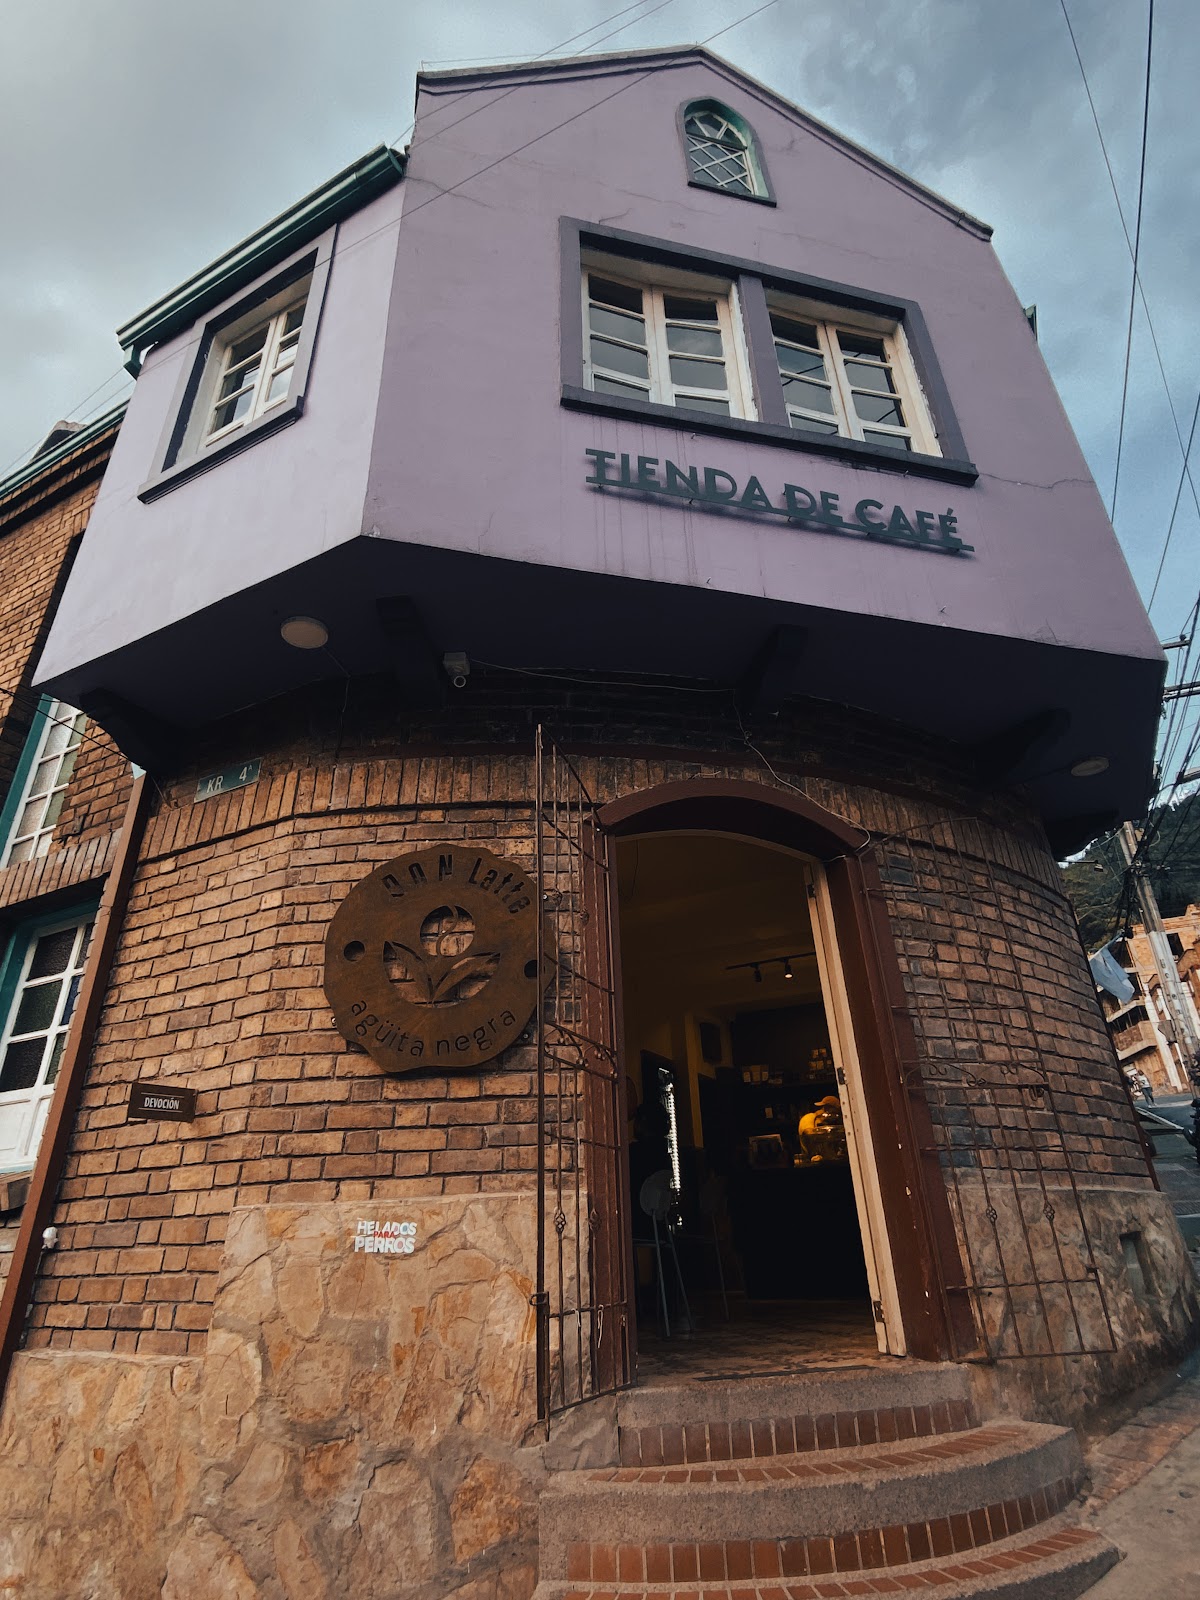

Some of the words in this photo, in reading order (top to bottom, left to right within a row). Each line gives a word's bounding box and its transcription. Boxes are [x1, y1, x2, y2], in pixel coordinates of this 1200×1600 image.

[585, 448, 775, 511] TIENDA
[783, 483, 844, 523] DE
[854, 498, 963, 545] CAFÉ
[206, 775, 224, 793] KR
[468, 857, 531, 914] Latte
[350, 1000, 425, 1058] agüita
[436, 1009, 517, 1057] negra
[144, 1097, 180, 1110] DEVOCIÓN
[357, 1220, 417, 1235] HELADOS
[373, 1231, 395, 1239] PARA
[354, 1236, 416, 1254] PERROS
